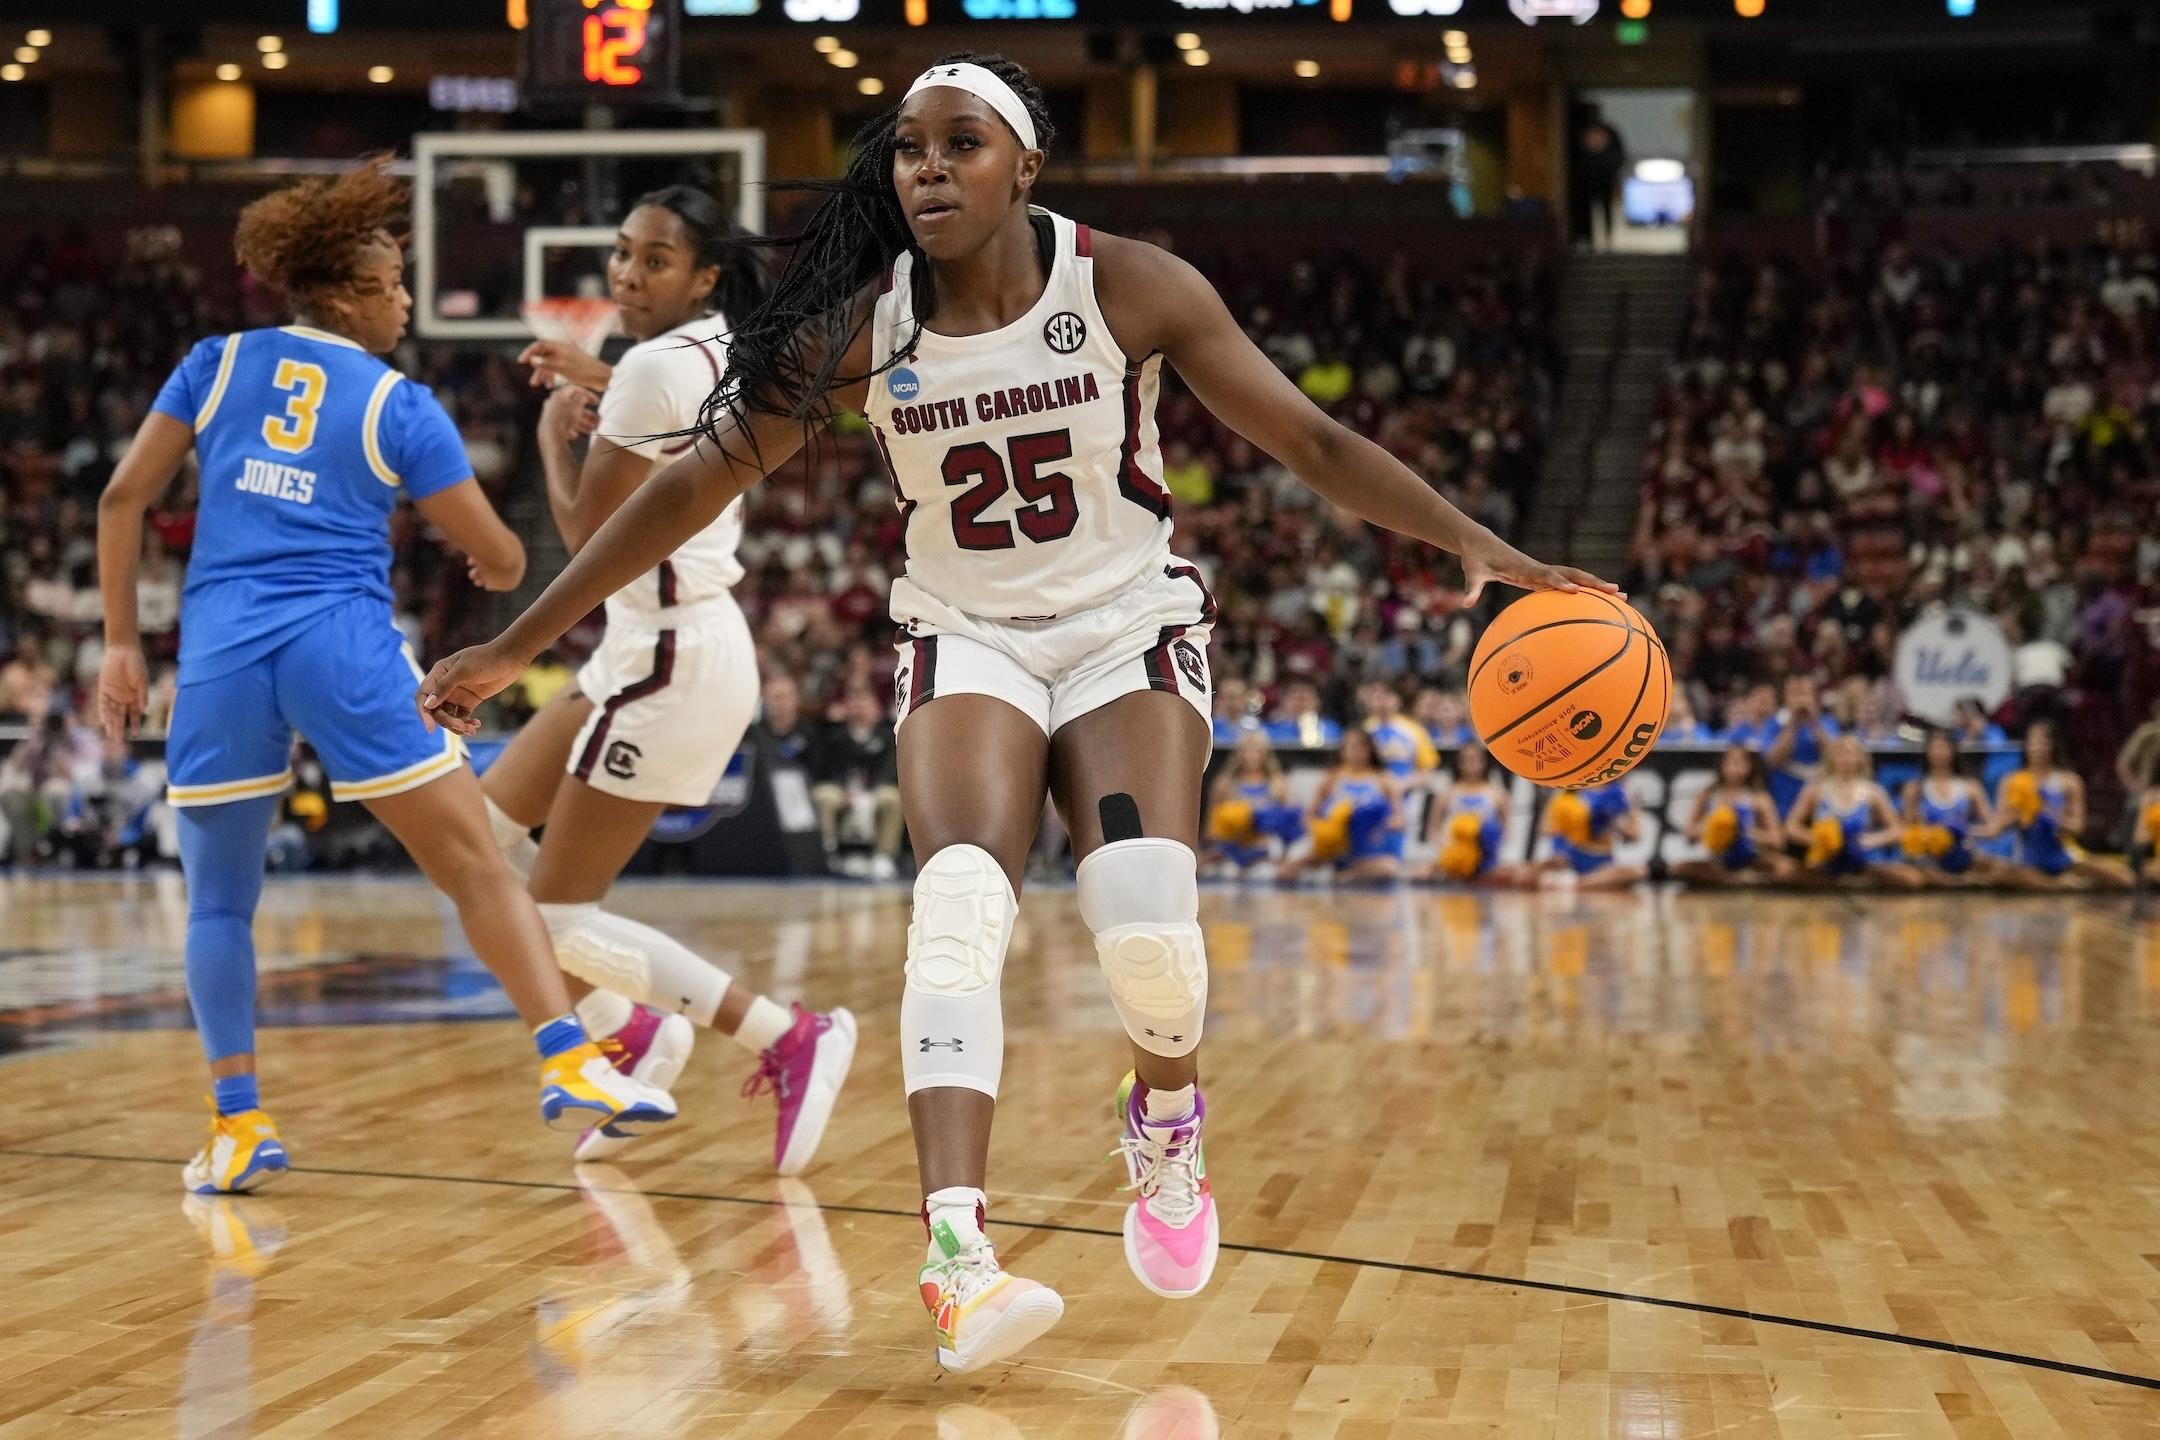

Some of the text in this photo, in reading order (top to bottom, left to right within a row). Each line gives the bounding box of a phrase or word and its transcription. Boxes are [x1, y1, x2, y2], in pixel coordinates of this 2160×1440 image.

[583, 8, 648, 85] 12
[1047, 313, 1084, 352] SEC
[262, 358, 328, 455] 3
[891, 372, 1100, 435] SOUTH CAROLINA
[892, 382, 919, 393] NCAA
[235, 458, 317, 505] JONES
[940, 428, 1080, 551] 25
[1517, 704, 1576, 744] 50th Anniversary
[1570, 712, 1595, 735] NCAA
